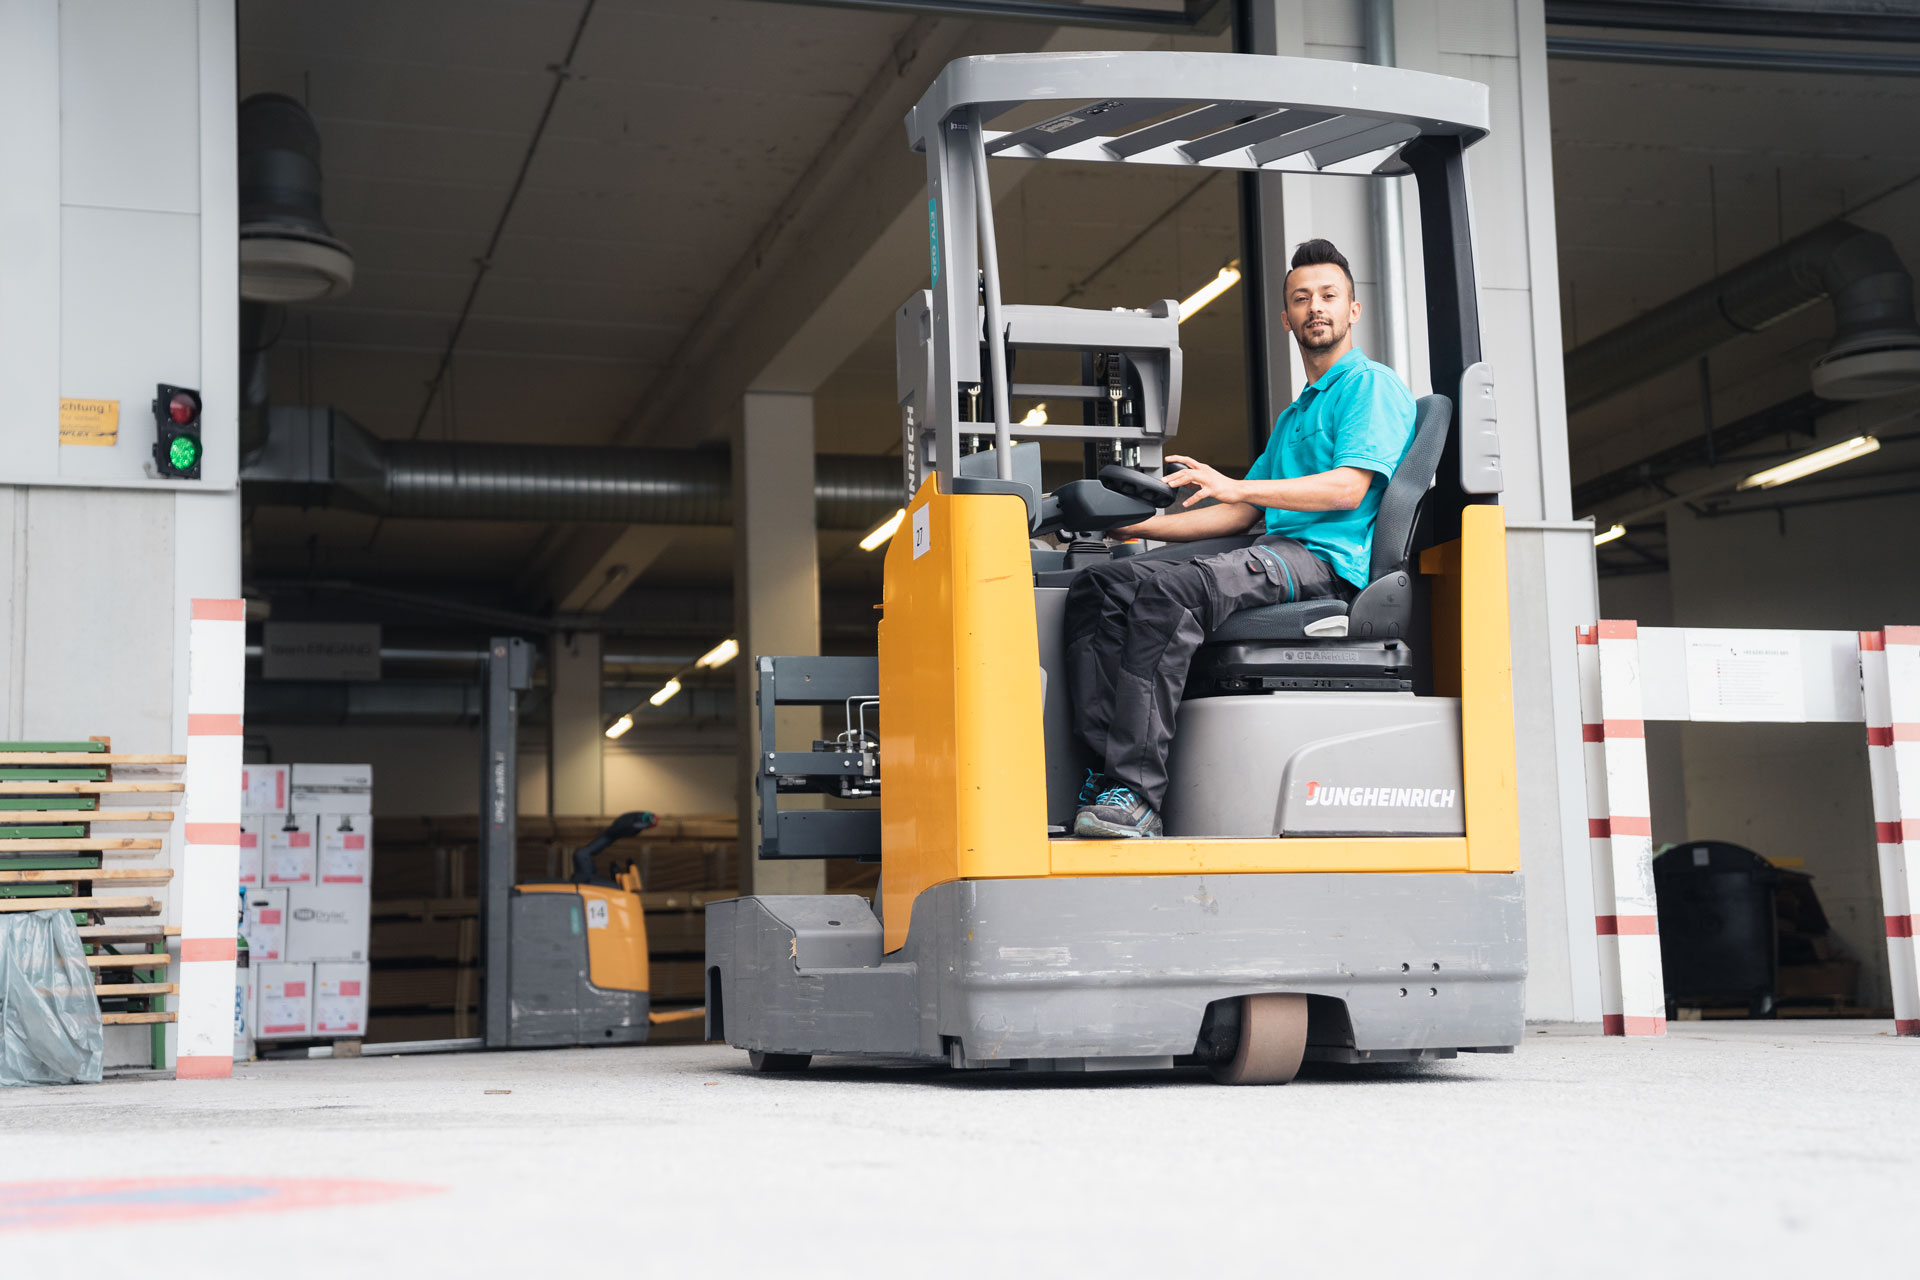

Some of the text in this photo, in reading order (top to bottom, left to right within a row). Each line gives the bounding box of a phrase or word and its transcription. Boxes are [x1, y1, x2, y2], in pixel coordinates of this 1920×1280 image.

[60, 402, 104, 414] chtung
[906, 405, 915, 502] INRICH
[916, 527, 923, 547] 27
[1296, 650, 1360, 662] GRAMMER
[1305, 781, 1456, 809] JUNGHEINRICH
[590, 906, 605, 920] 14
